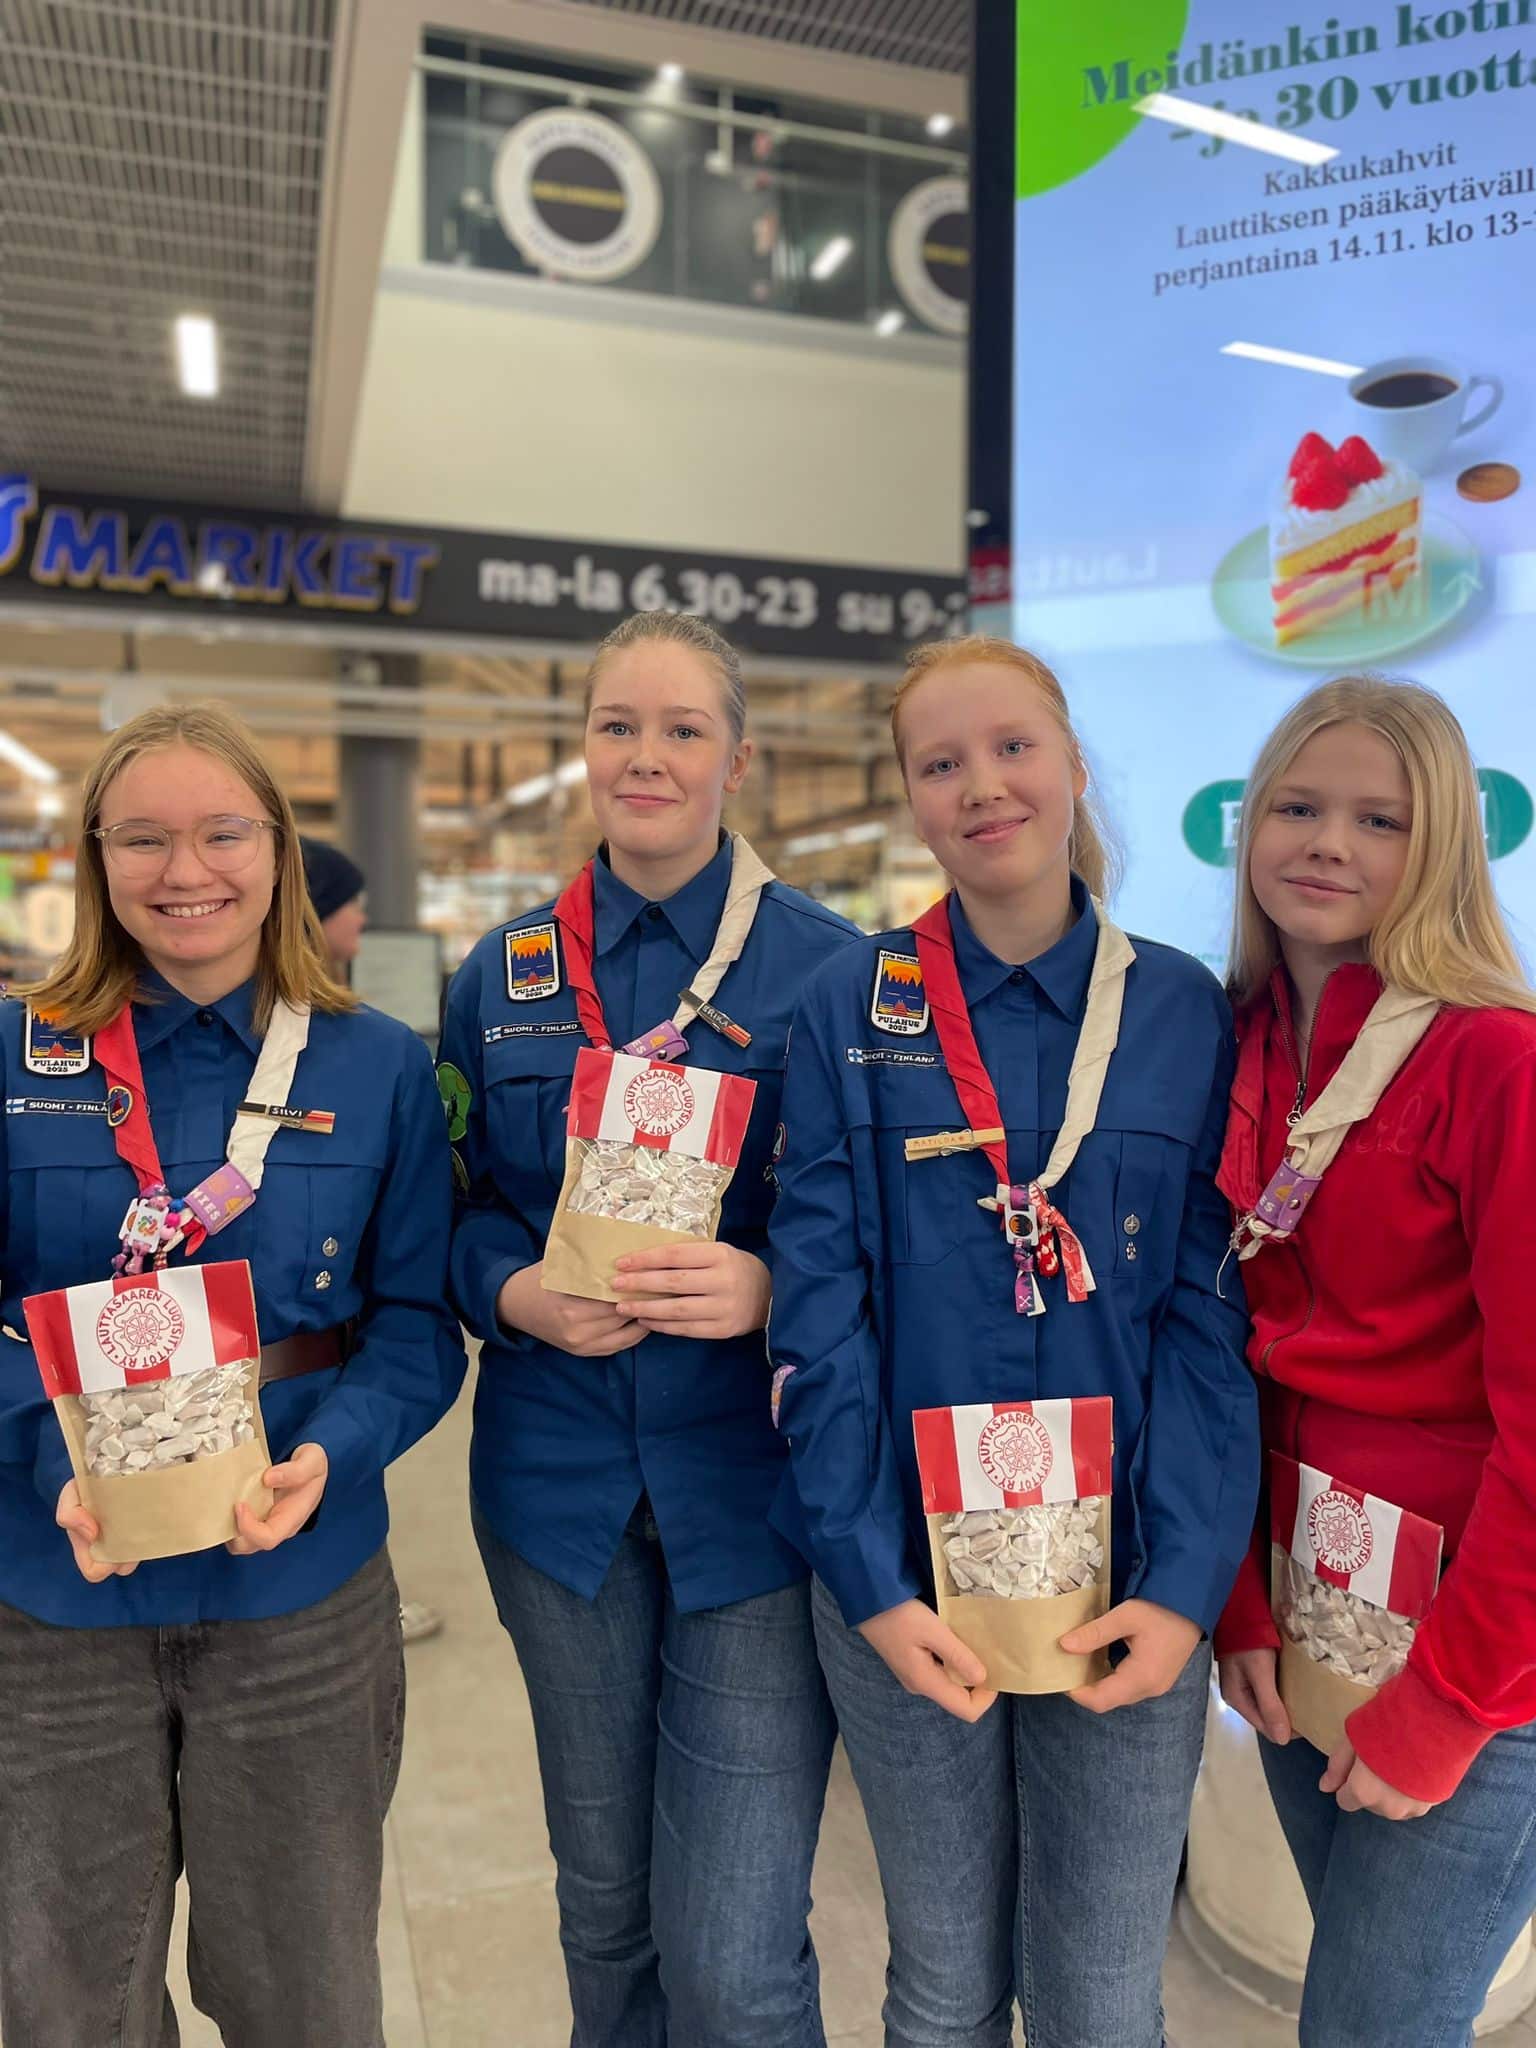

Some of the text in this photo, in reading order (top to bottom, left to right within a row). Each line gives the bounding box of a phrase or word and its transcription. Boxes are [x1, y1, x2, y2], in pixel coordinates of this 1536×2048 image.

[1081, 18, 1379, 108] Meidänkin
[1276, 75, 1358, 129] 30
[1264, 142, 1456, 196] Kakkukahvit
[1176, 206, 1329, 249] Lauttiksen
[1154, 246, 1319, 296] perjantaina
[1329, 228, 1415, 263] 14.11.
[1426, 219, 1473, 247] klo
[32, 507, 439, 612] MARKET
[479, 556, 622, 611] ma-la
[630, 563, 818, 629] 6.30-23
[838, 591, 894, 634] su
[541, 1023, 578, 1032] FINLAND
[893, 1054, 935, 1062] FINLAND
[28, 1101, 65, 1110] SUOMI
[626, 1070, 685, 1113] LAUTTASAAREN
[99, 1289, 162, 1358] LAUTTASAAREN
[119, 1358, 138, 1368] RY
[980, 1413, 1035, 1474] LAUTTASAAREN
[998, 1478, 1015, 1490] RY
[1308, 1492, 1364, 1537] LAUTTASAAREN
